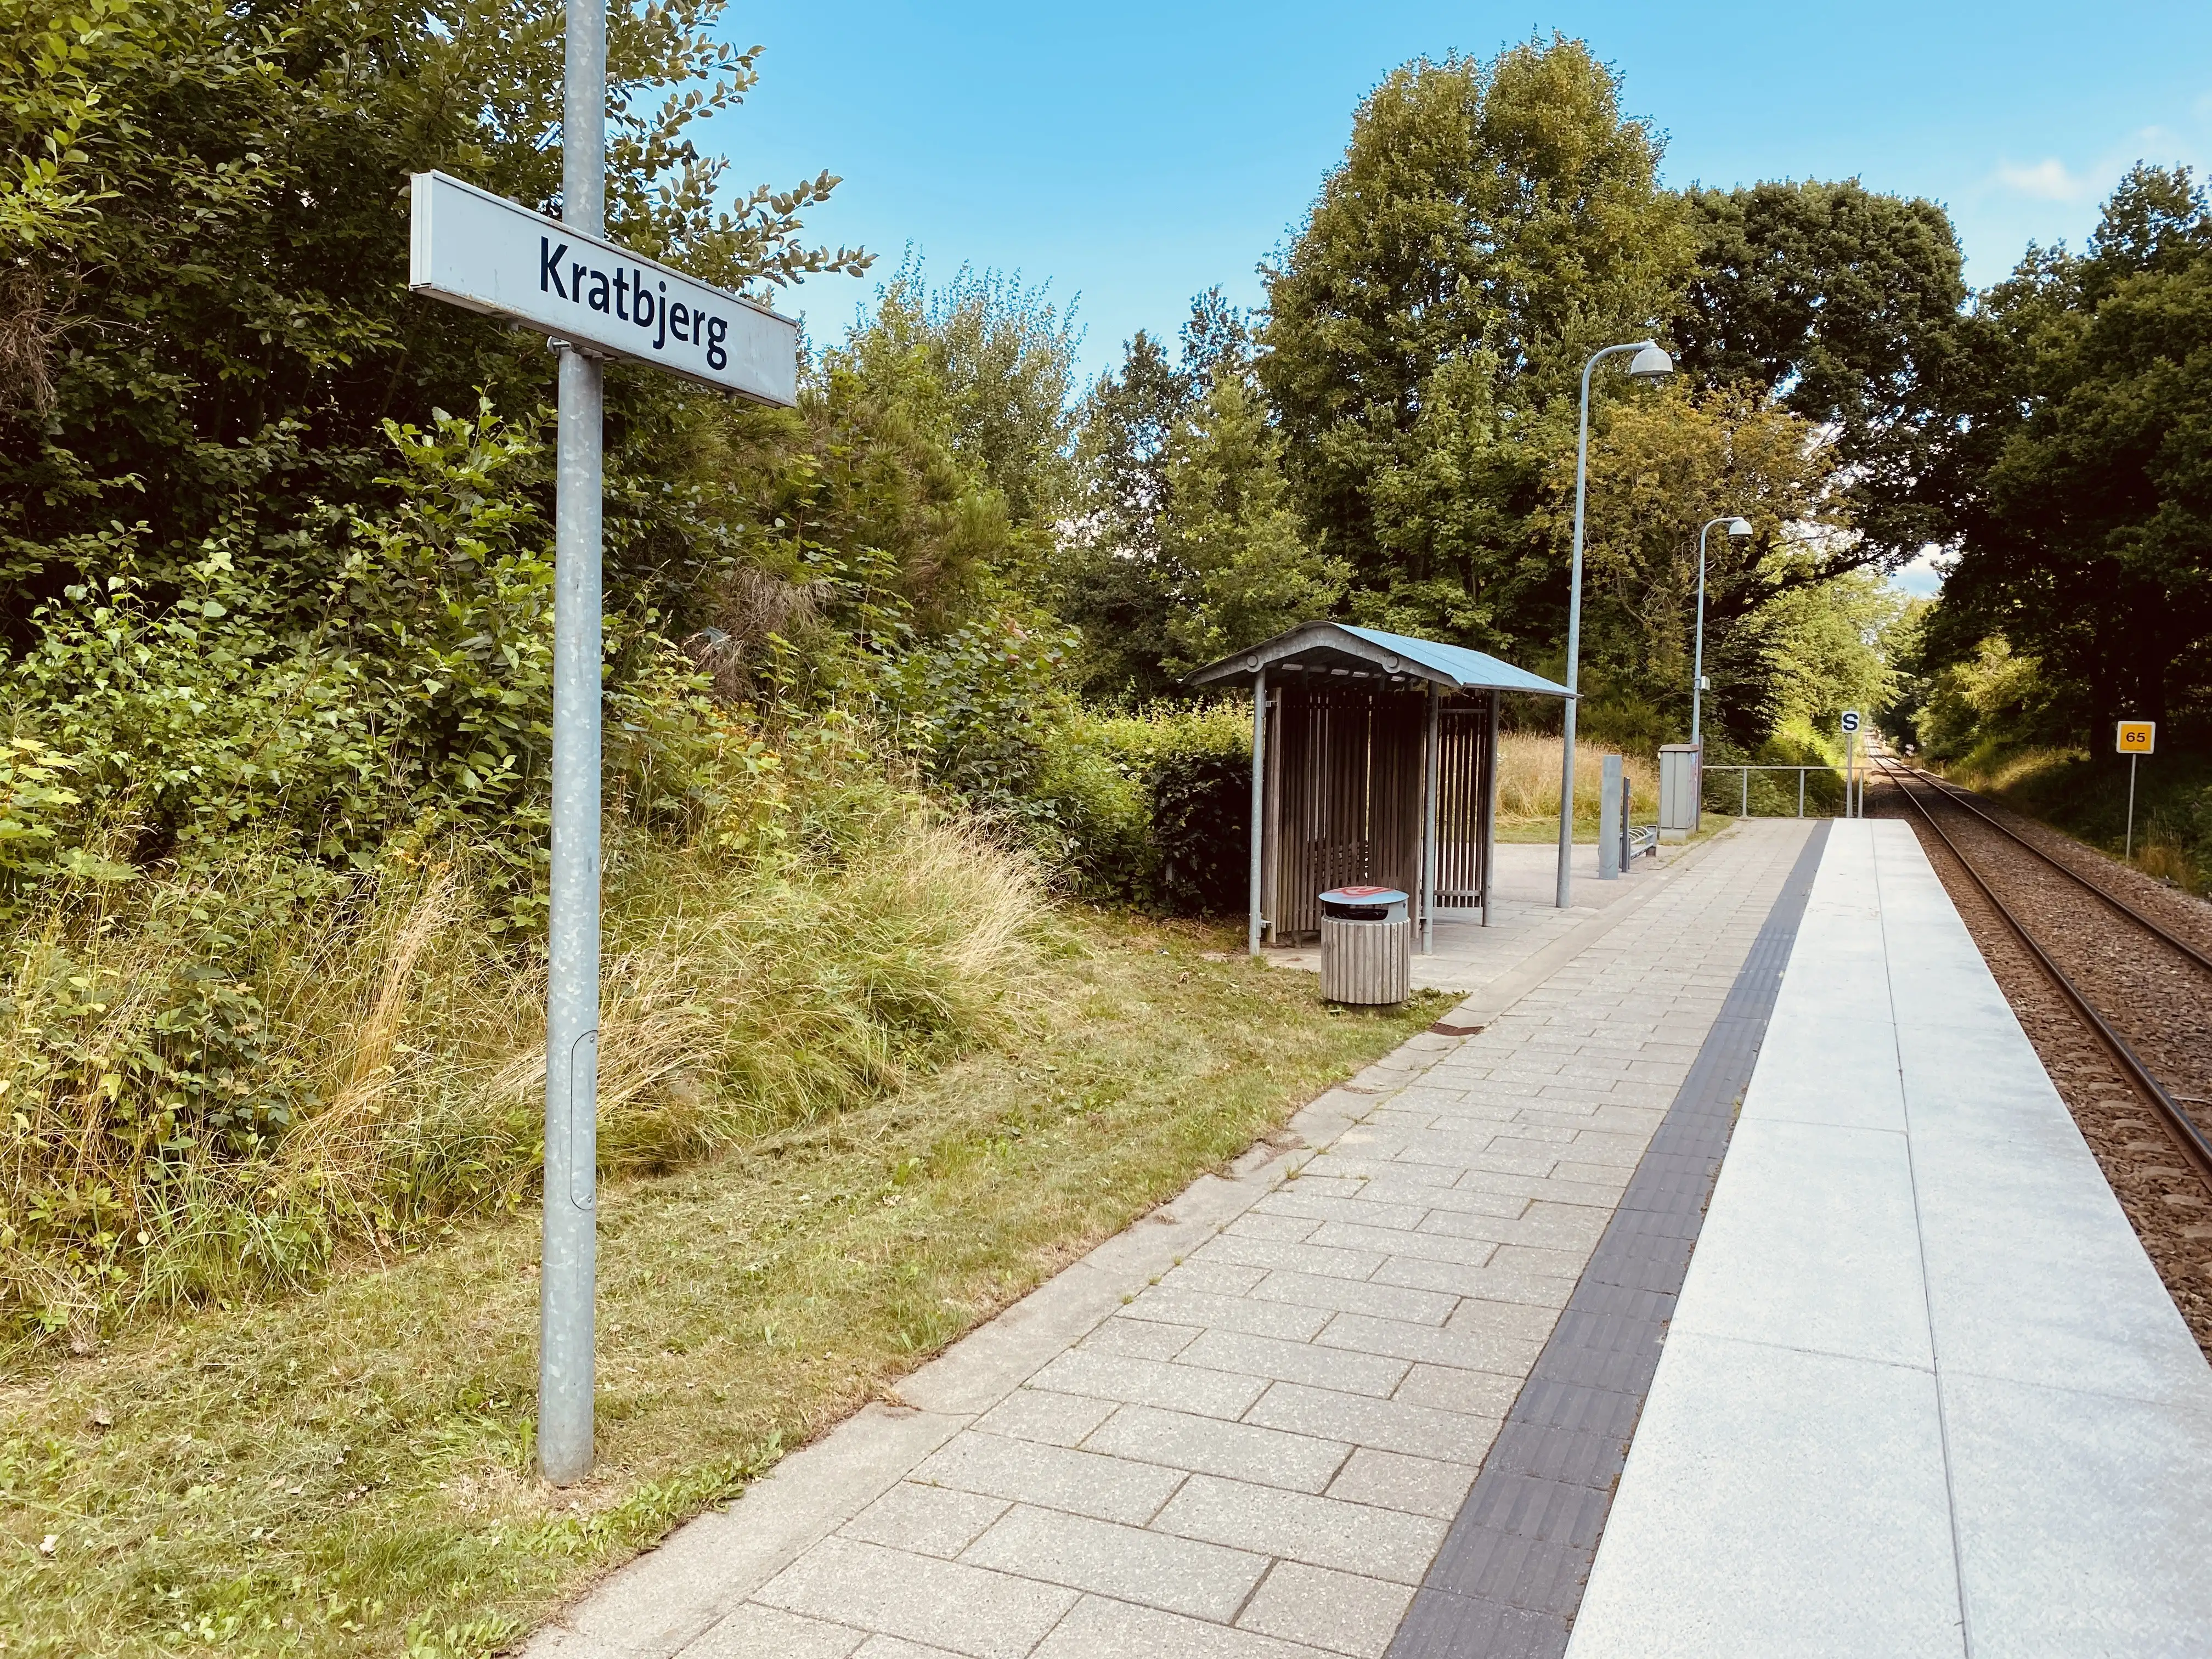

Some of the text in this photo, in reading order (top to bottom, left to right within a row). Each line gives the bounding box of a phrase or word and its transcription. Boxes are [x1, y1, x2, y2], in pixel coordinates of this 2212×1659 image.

[540, 235, 728, 370] Kratbjerg
[1843, 713, 1859, 731] S
[2126, 732, 2146, 742] 65
